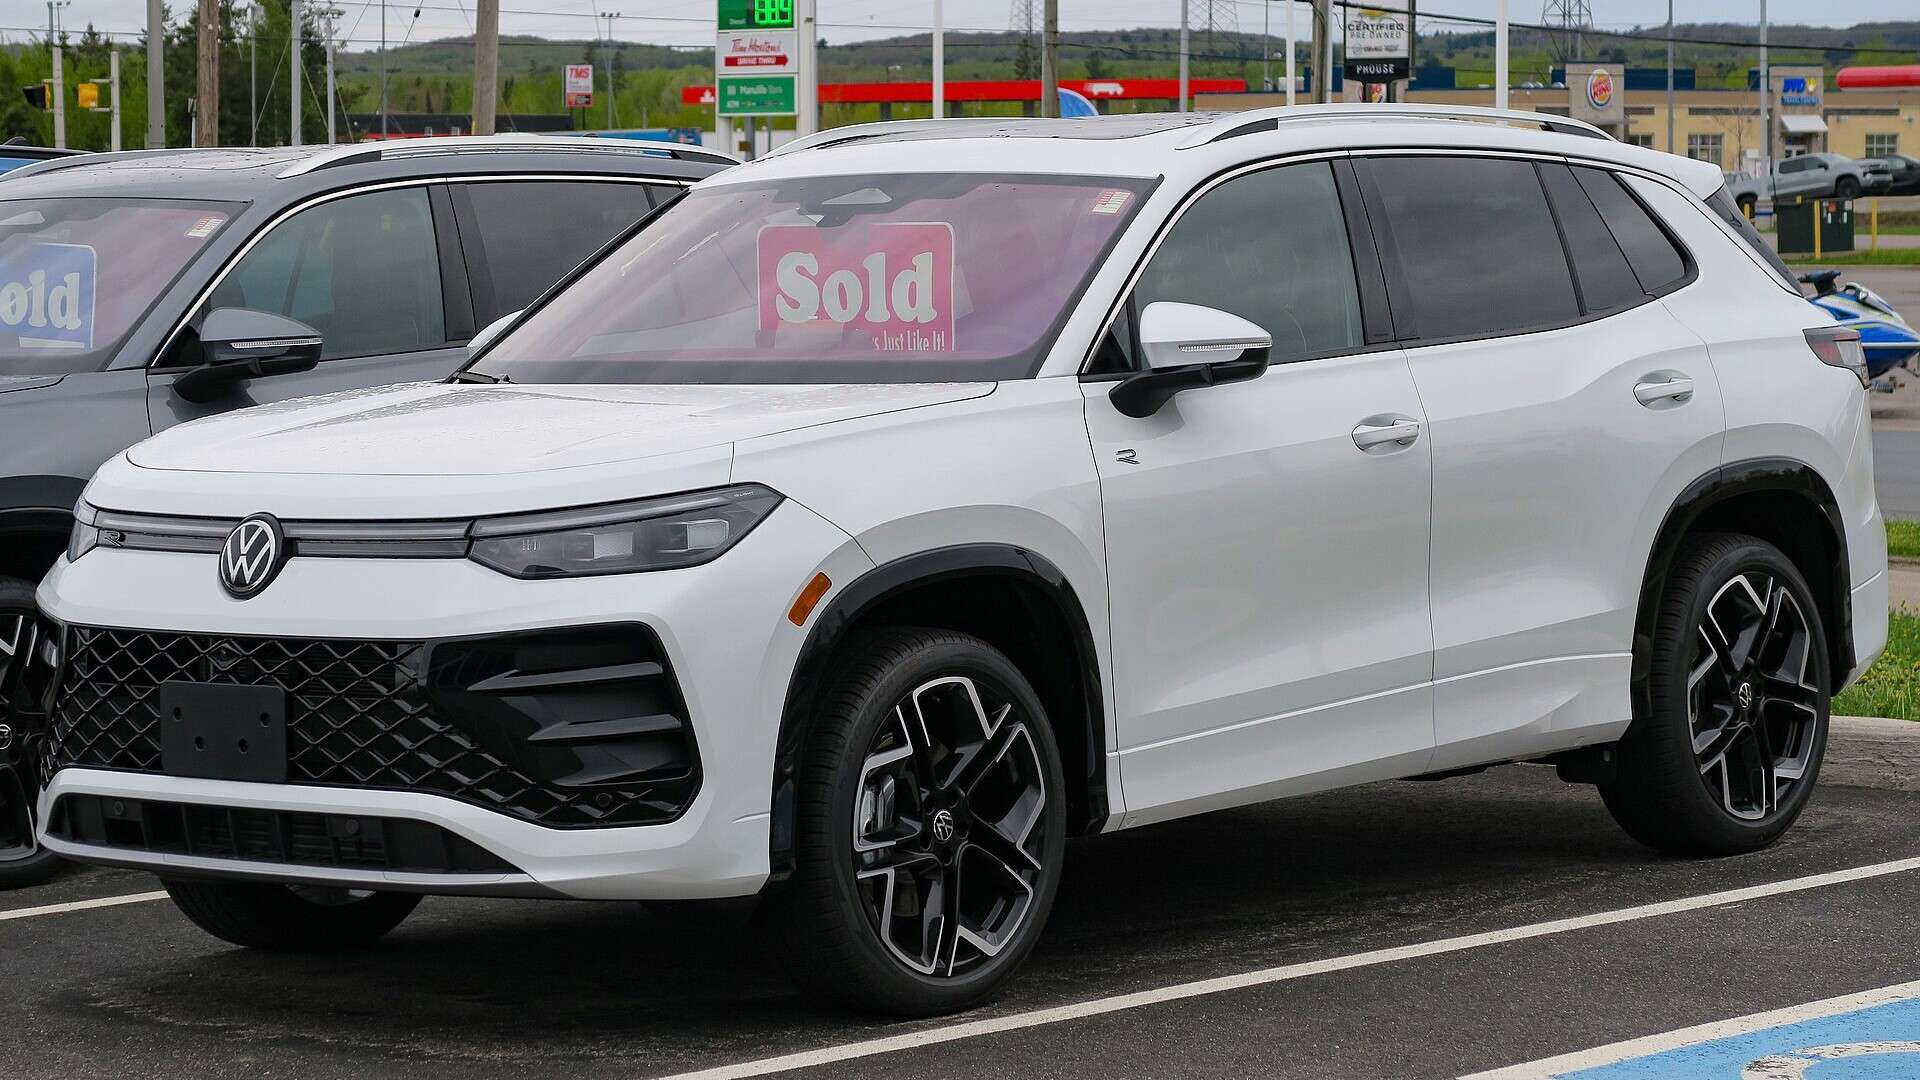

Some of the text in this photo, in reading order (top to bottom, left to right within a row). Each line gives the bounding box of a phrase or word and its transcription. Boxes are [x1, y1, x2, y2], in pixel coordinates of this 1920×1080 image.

[1348, 23, 1404, 31] CERTIFIED
[569, 67, 590, 79] TMS
[776, 251, 937, 323] Sold
[883, 329, 904, 351] Just
[907, 329, 929, 351] Like
[933, 330, 945, 351] It!
[221, 519, 276, 592] VW
